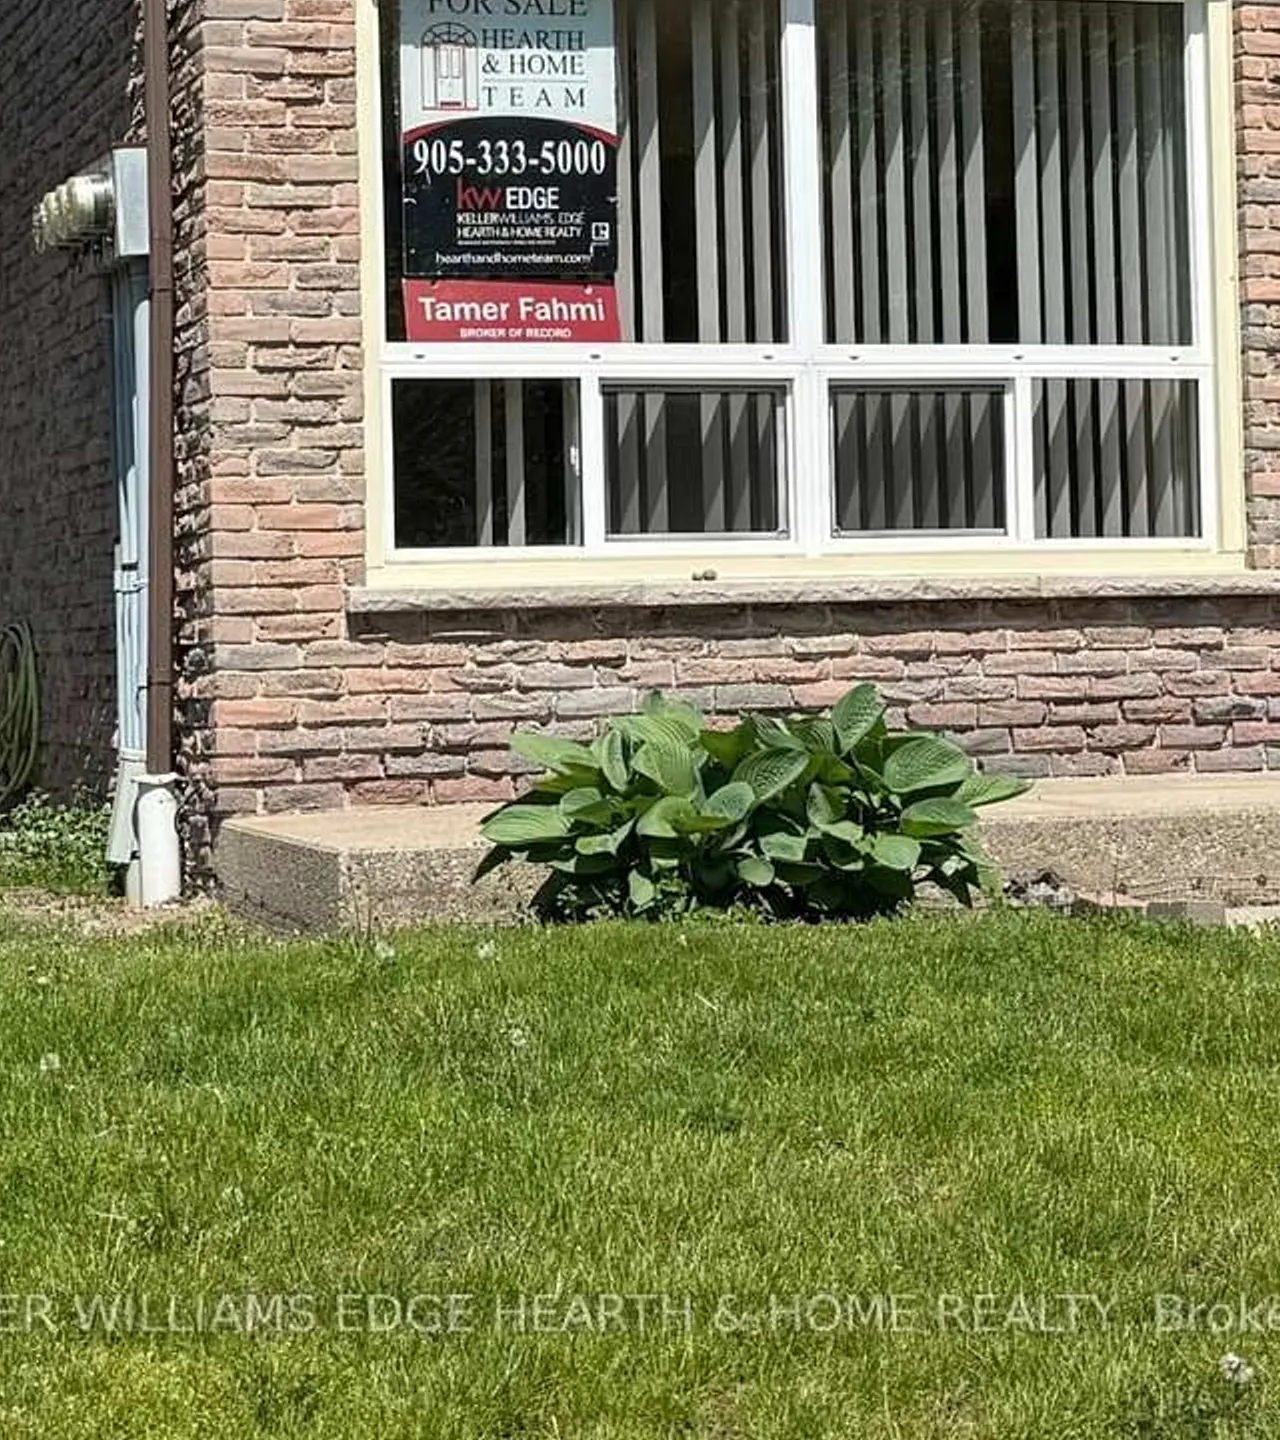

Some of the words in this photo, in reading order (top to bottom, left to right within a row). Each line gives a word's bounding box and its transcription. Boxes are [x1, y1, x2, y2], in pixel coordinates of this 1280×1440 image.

[481, 28, 586, 51] HEARTH
[481, 53, 502, 74] &
[509, 54, 585, 76] HOME
[481, 86, 586, 108] TEAM
[413, 139, 606, 176] 905-333-5000
[457, 177, 503, 210] kw
[505, 186, 560, 210] EDGE
[418, 296, 510, 321] Tamer
[519, 296, 605, 321] Fahmi
[460, 327, 506, 338] BROKER
[509, 327, 523, 338] OF
[526, 327, 572, 338] RECORD
